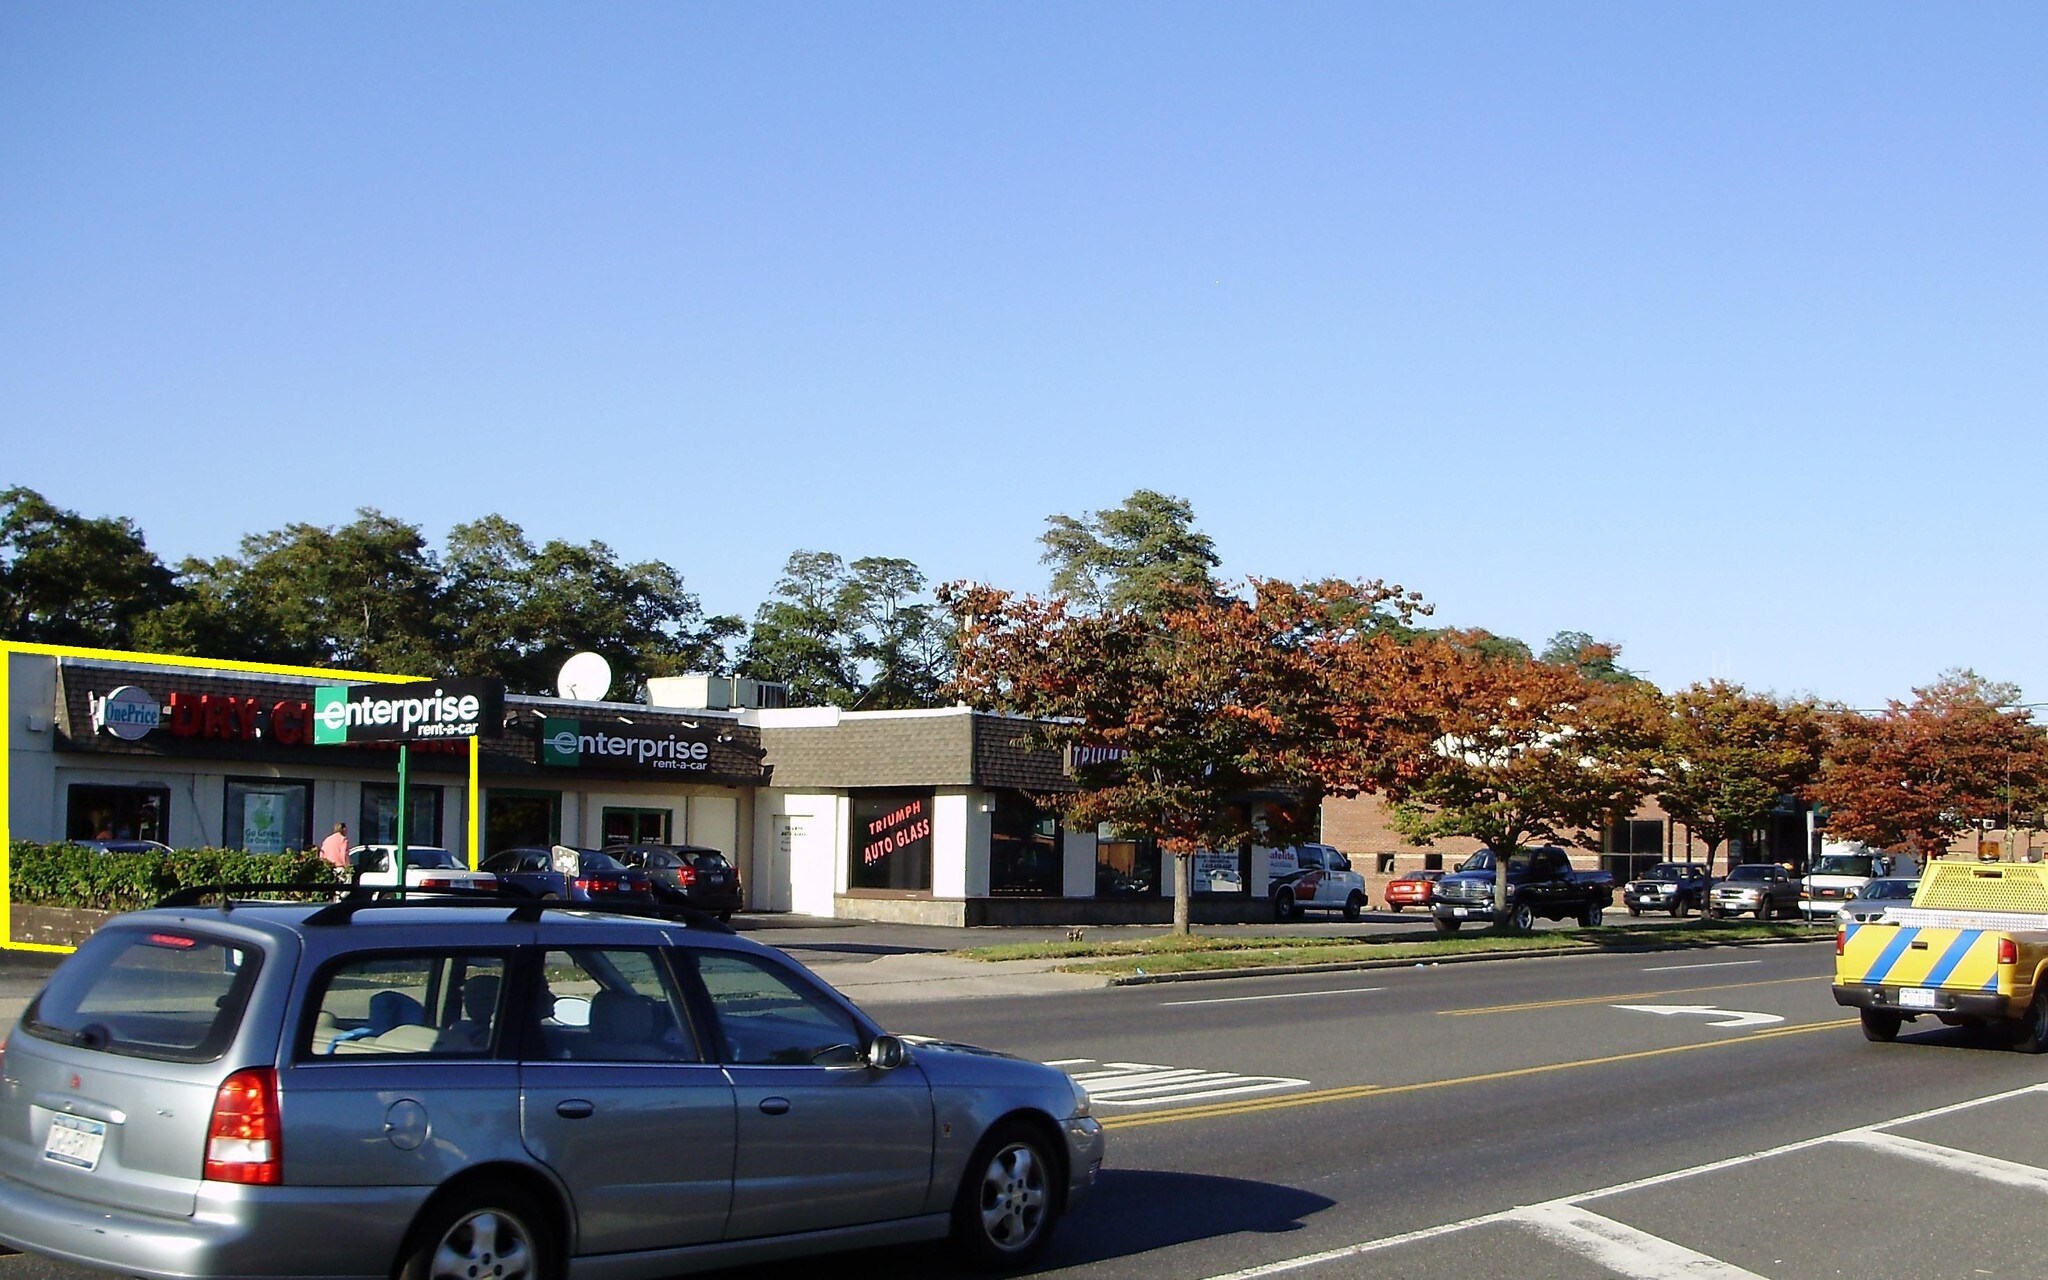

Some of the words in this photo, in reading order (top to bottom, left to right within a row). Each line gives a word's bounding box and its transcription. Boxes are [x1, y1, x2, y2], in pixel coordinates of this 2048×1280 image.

[106, 701, 158, 725] OnePrice
[170, 692, 257, 740] DRY
[315, 689, 480, 733] enterprise
[418, 722, 479, 736] rent-a-car
[544, 731, 709, 764] enterprise
[653, 759, 708, 771] rent-a-car
[868, 800, 921, 836] TRIUMPH
[864, 837, 893, 864] AUTO
[896, 818, 930, 847] GLASS
